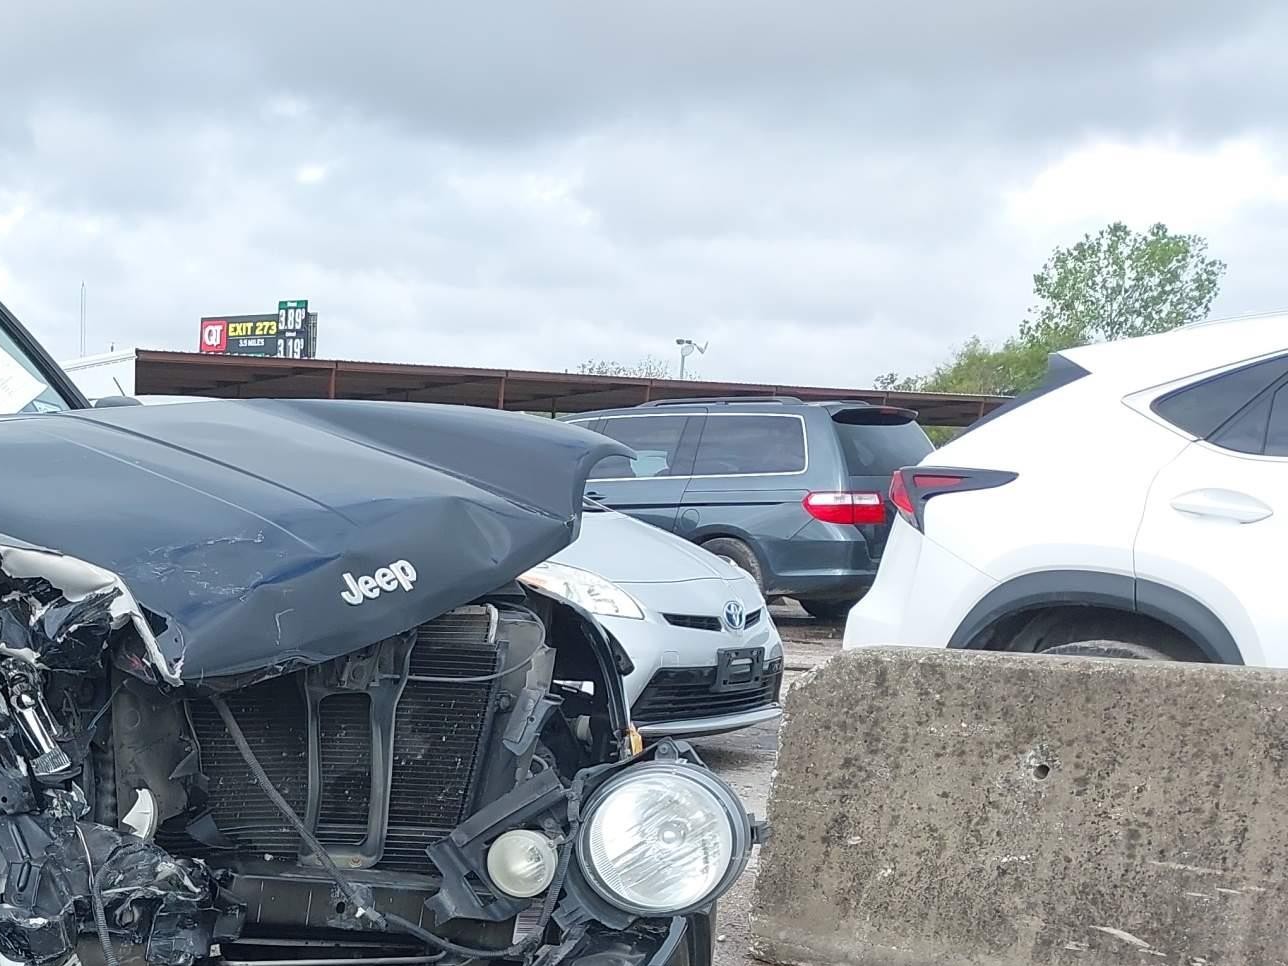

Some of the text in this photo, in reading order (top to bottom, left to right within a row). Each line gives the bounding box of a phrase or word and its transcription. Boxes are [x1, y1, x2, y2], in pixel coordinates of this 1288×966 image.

[204, 325, 223, 348] QT
[228, 322, 254, 337] EXIT
[255, 321, 278, 335] 273
[340, 559, 417, 605] Jeep
